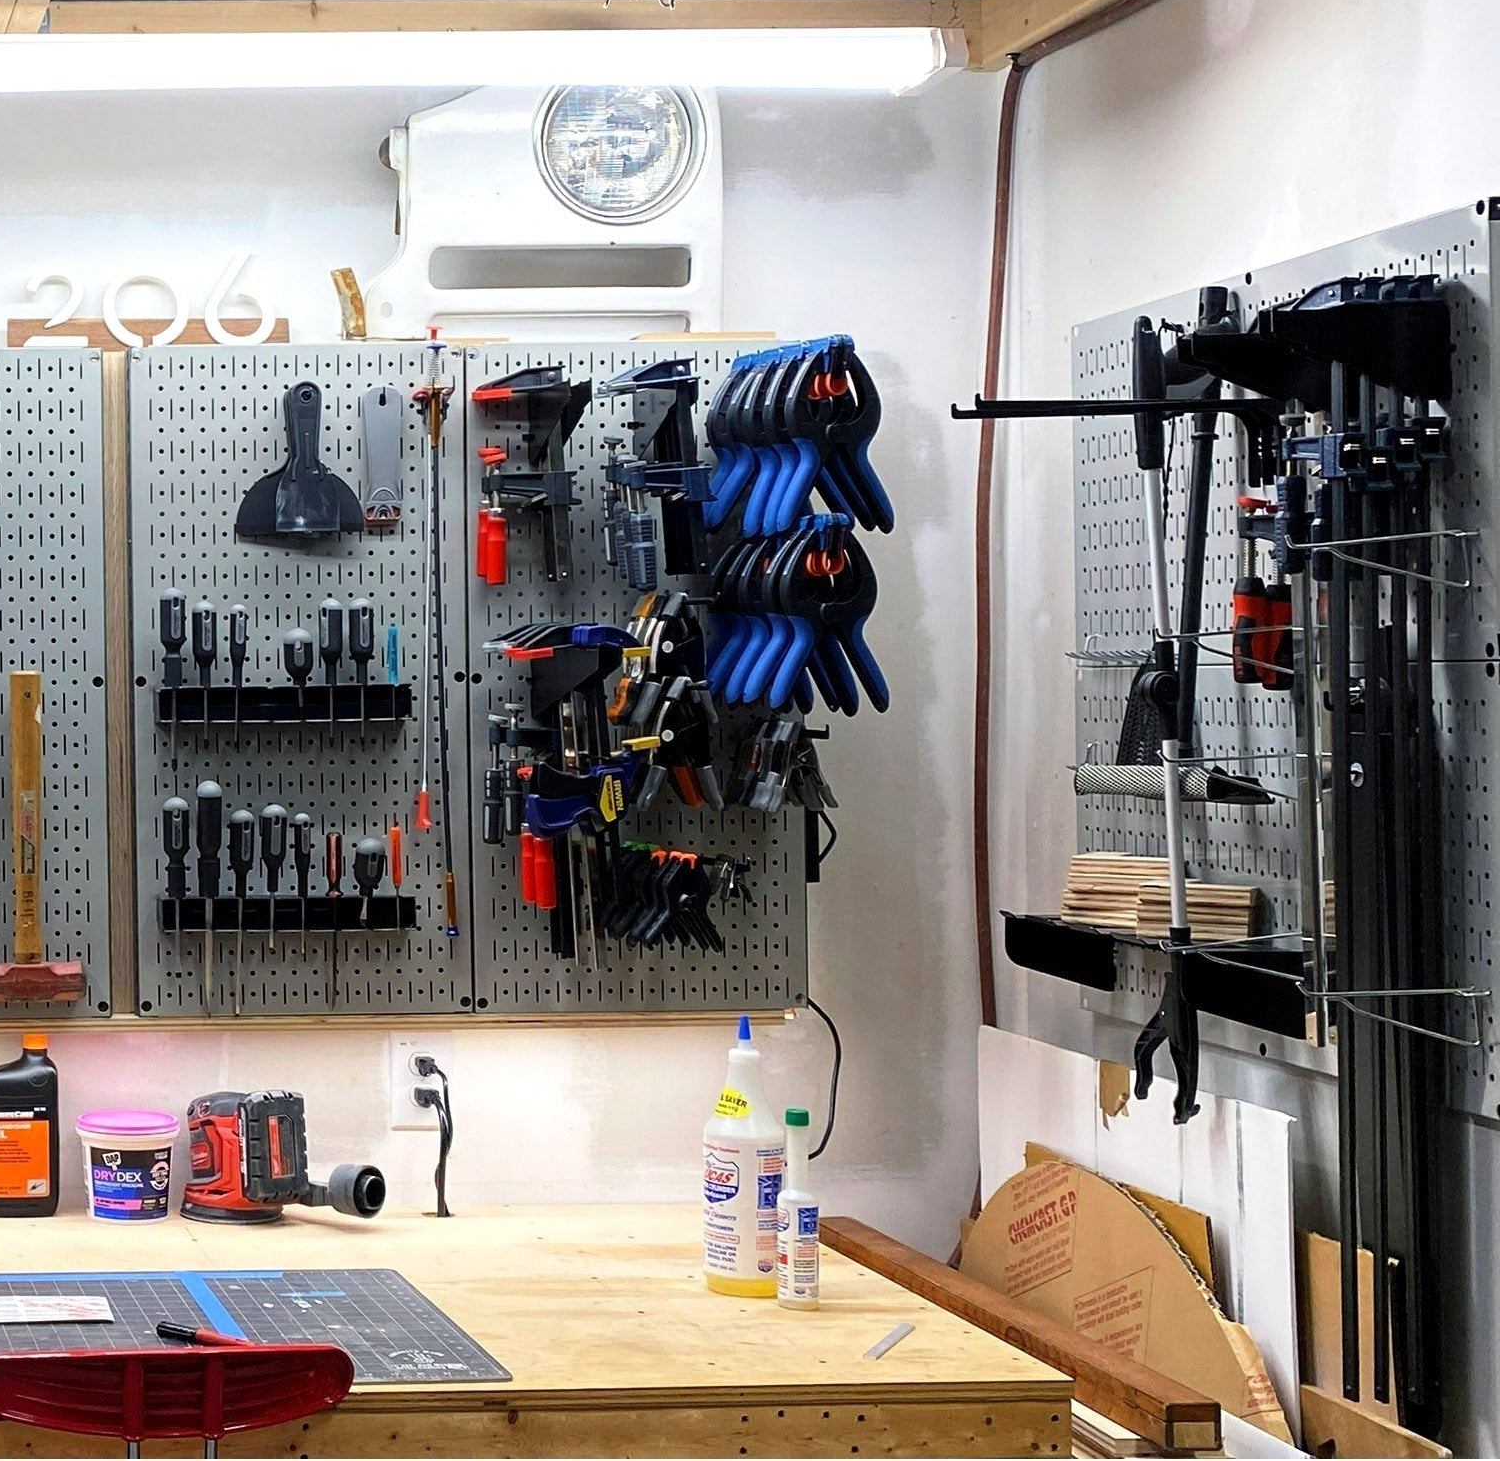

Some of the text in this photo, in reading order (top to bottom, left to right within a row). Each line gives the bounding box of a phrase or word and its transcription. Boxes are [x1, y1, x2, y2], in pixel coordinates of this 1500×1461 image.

[23, 250, 276, 347] 206
[613, 779, 624, 811] IRWIN
[105, 1153, 120, 1163] DAP
[93, 1169, 142, 1182] DRYDEX
[705, 1168, 735, 1184] UCAS
